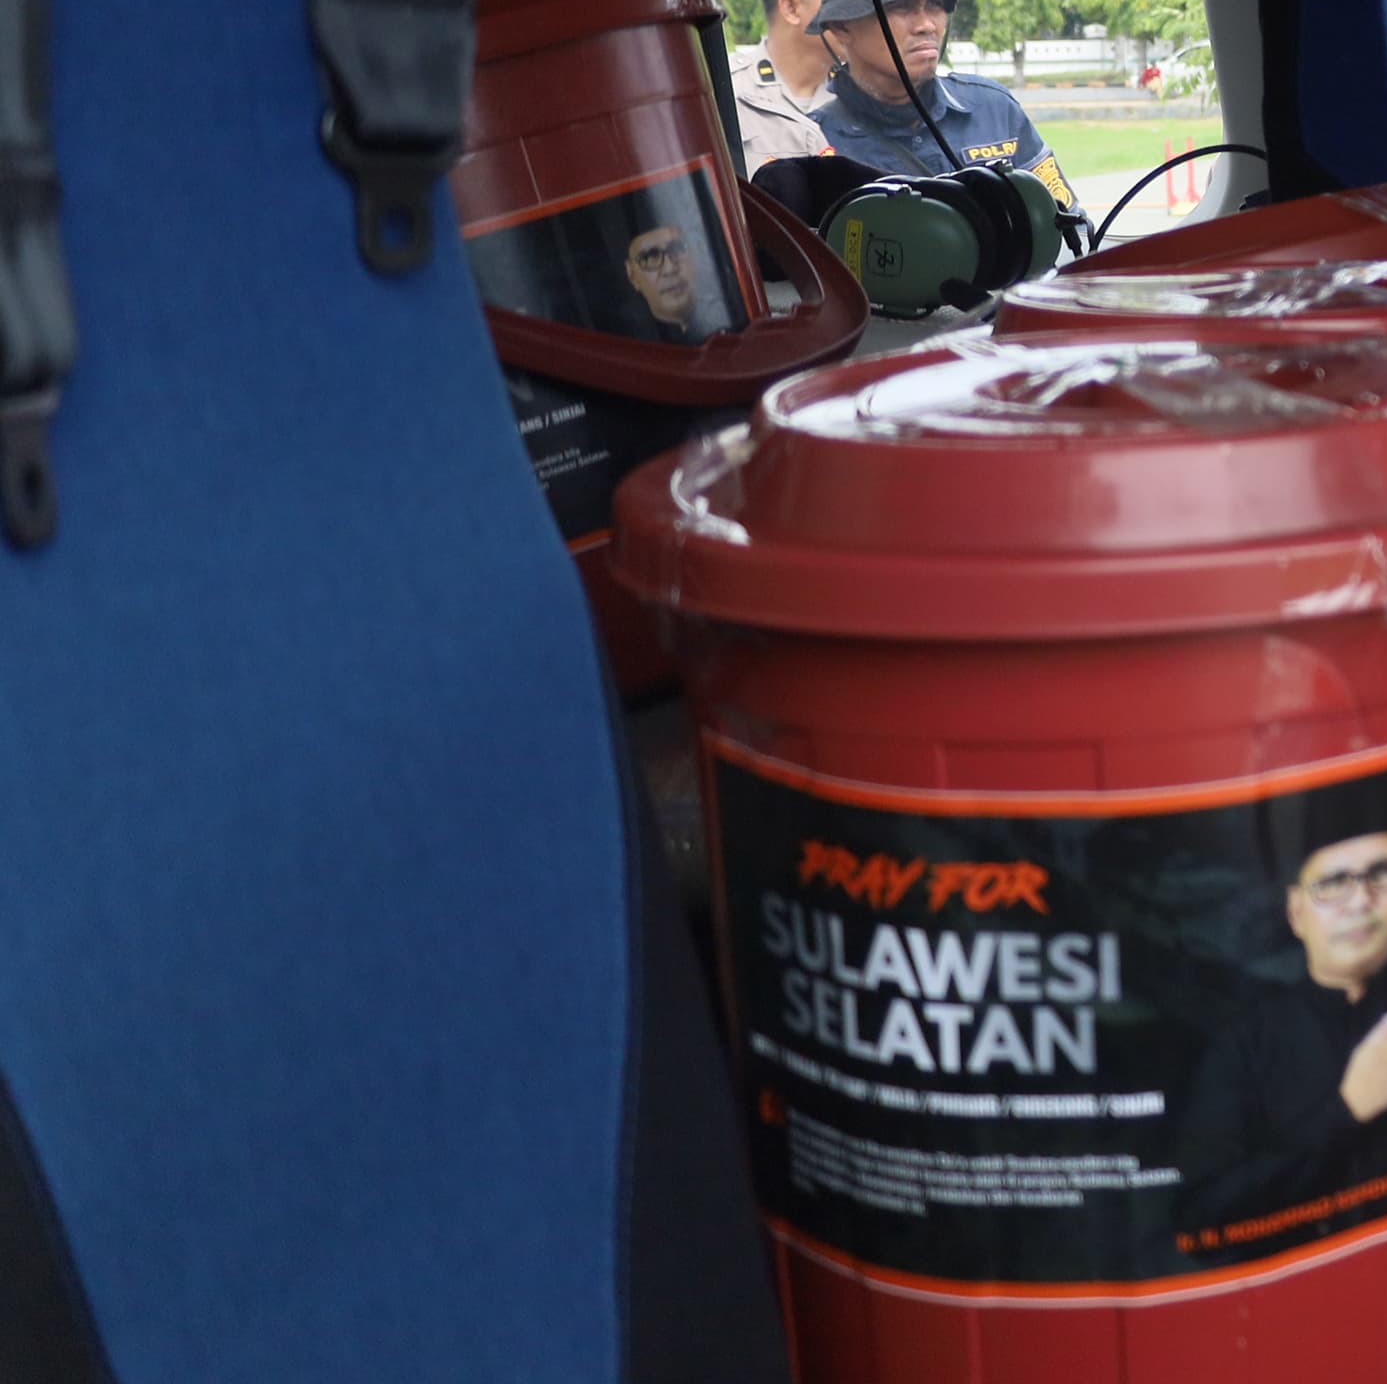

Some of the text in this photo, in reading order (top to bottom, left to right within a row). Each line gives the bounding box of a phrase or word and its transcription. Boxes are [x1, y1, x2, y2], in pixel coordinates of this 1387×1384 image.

[968, 141, 1017, 160] POLRI
[800, 841, 1050, 916] PRAY FOR
[761, 890, 1122, 1003] SULAWESI
[782, 966, 1098, 1075] SELATAN
